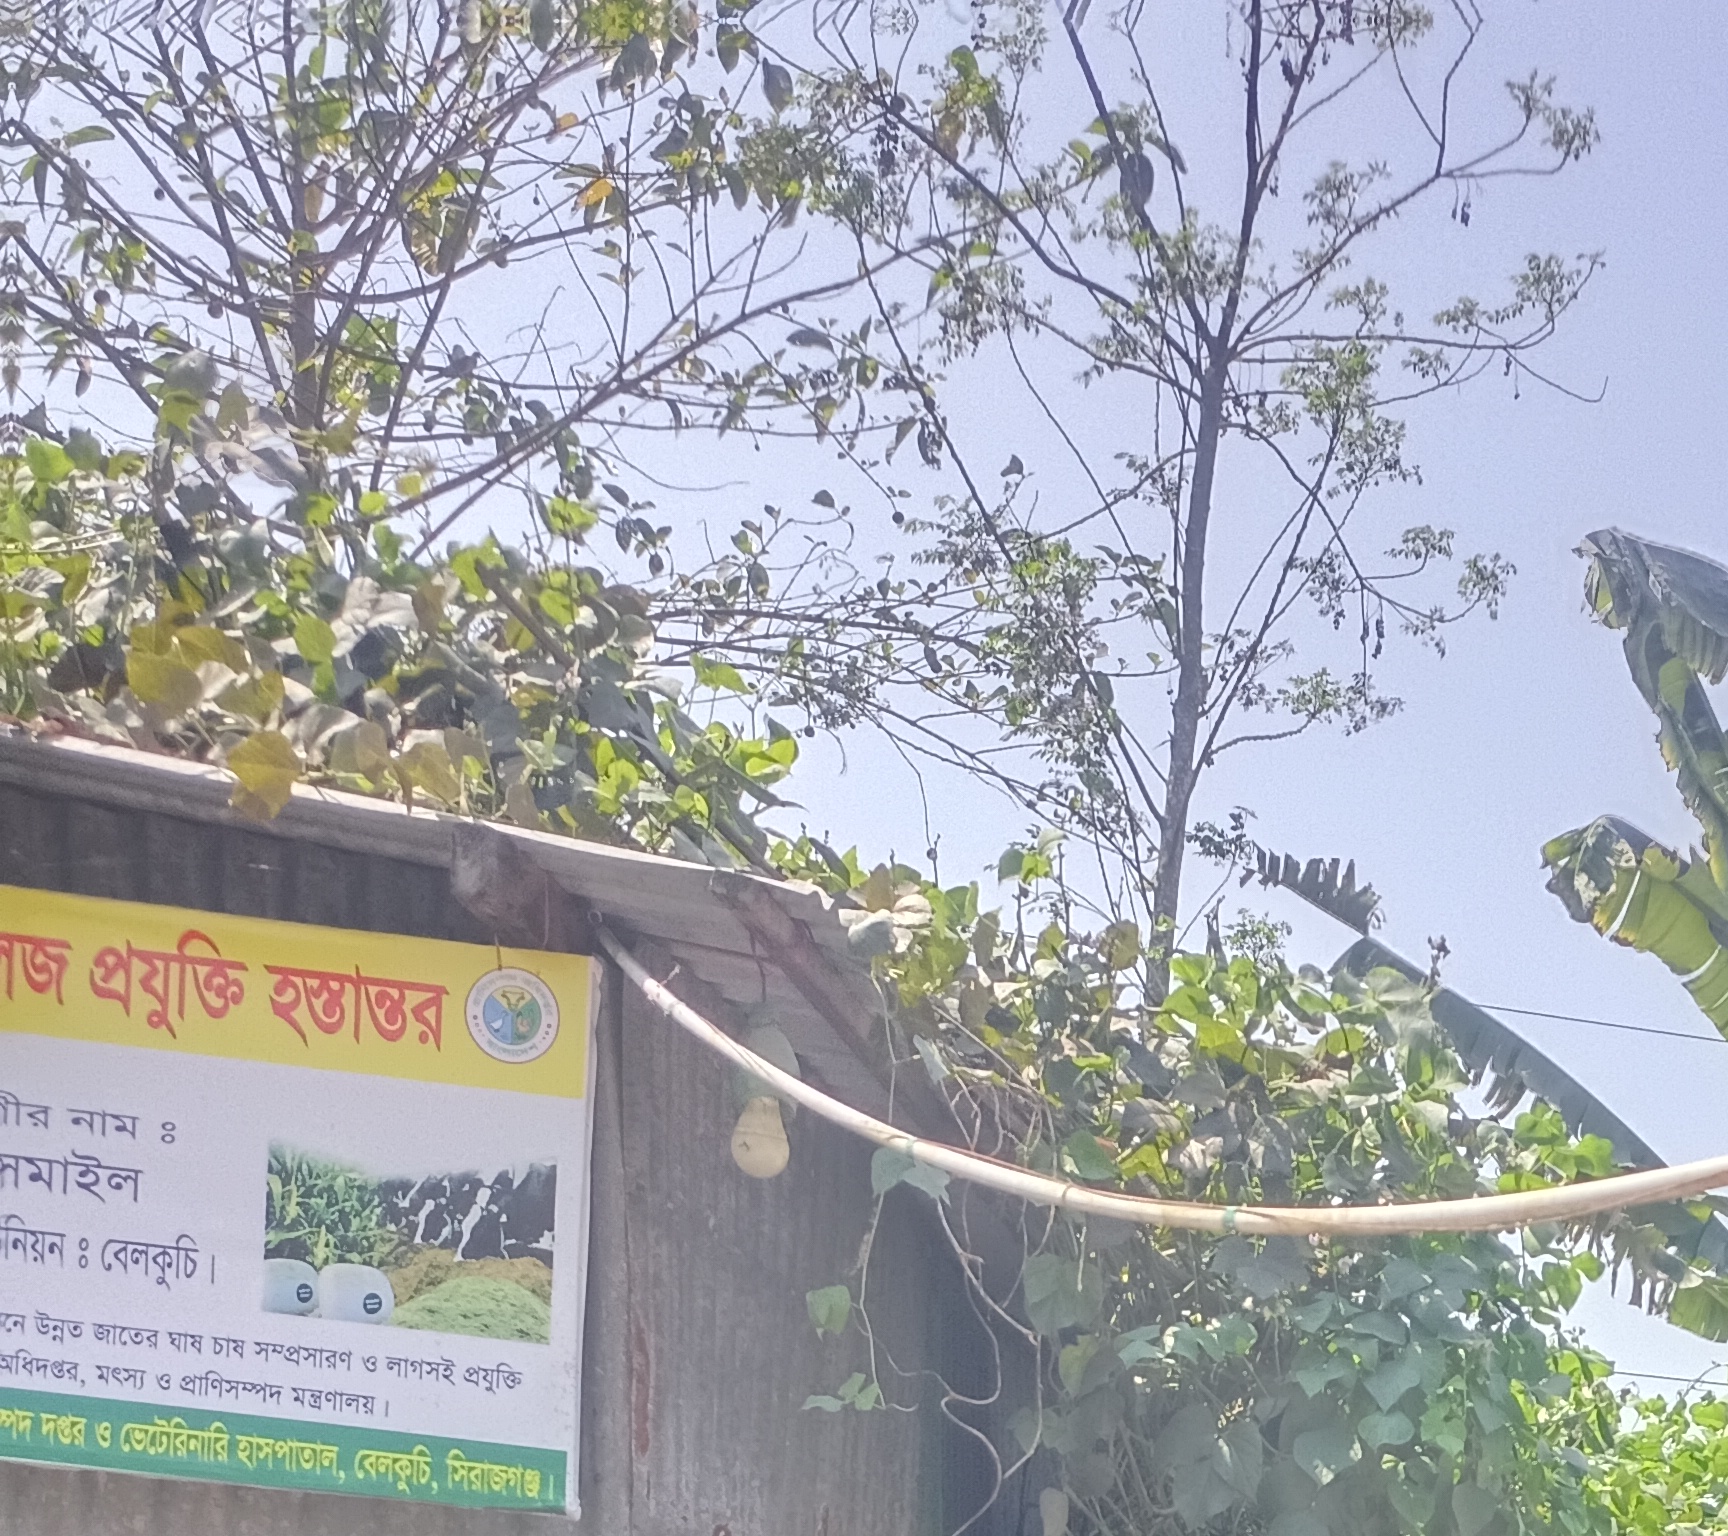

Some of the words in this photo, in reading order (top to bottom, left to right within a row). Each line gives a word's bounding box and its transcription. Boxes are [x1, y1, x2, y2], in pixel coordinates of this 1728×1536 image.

[89, 928, 249, 1040] প্রযুক্তি
[262, 963, 450, 1053] হস্তান্তর
[66, 1108, 141, 1140] নাম
[101, 1233, 200, 1291] বেলকুচি
[34, 1310, 85, 1345] উন্নত
[92, 1322, 160, 1350] জাতের
[211, 1335, 246, 1360] চাষ
[253, 1340, 353, 1372] সম্প্রসারণ
[361, 1355, 378, 1373] ও
[386, 1355, 457, 1386] লাগসই
[463, 1362, 524, 1395] প্রযুক্তি
[95, 1364, 147, 1391] মৎস্য
[155, 1372, 172, 1391] ও
[179, 1370, 284, 1406] প্রাণিসম্পদ
[291, 1385, 376, 1416] মন্ত্রণালয়
[40, 1412, 88, 1449] দপ্তর
[95, 1421, 112, 1449] ও
[119, 1413, 231, 1464] ভেটেরিনারি
[235, 1432, 346, 1485] হাসপাতাল,
[354, 1443, 439, 1496] বেলকুচি,
[445, 1447, 542, 1500] সিরাজগঞ্জ
